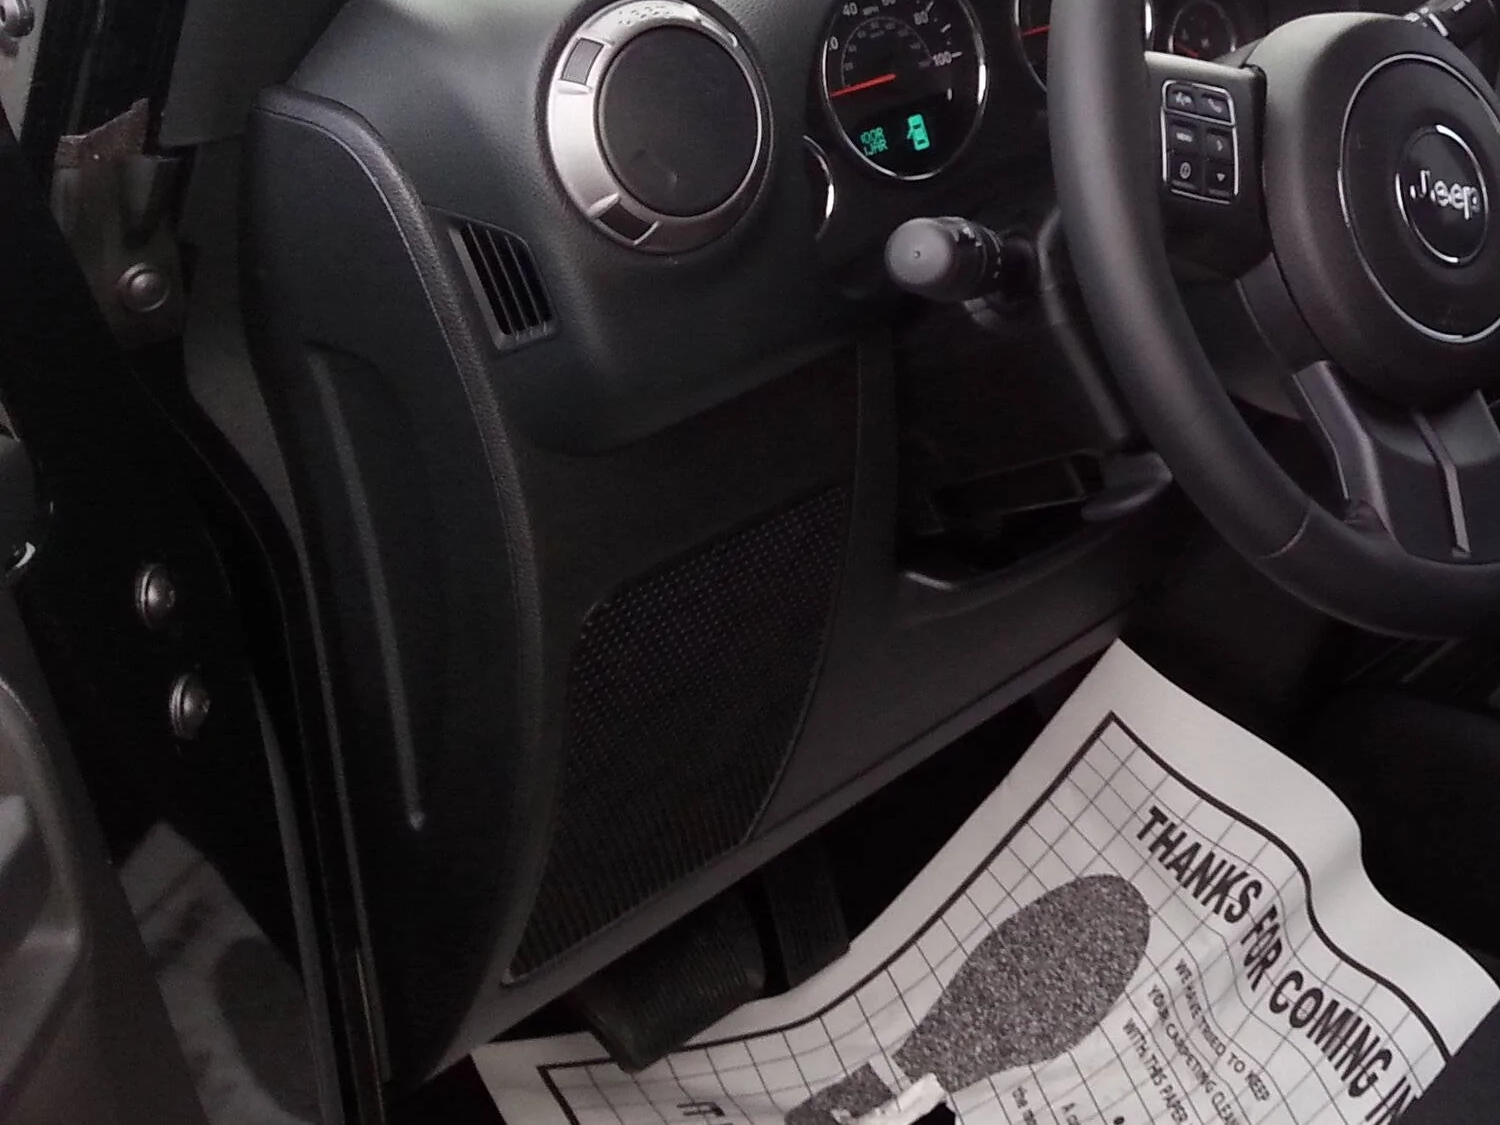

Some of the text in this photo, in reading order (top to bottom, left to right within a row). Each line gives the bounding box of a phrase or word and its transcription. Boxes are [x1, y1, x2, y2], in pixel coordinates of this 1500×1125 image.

[842, 2, 858, 15] 40
[932, 51, 952, 67] 100
[1410, 169, 1481, 220] Jeep
[1137, 806, 1262, 923] THANKS
[1241, 905, 1282, 992] FOR
[1269, 970, 1393, 1098] COMING
[1123, 1017, 1189, 1125] WITH THIS PAPER
[1148, 984, 1171, 1025] YOUR
[1166, 1022, 1217, 1095] CARPETING
[1175, 959, 1193, 984] WE
[1200, 1016, 1226, 1057] TRIED
[1227, 1052, 1246, 1074] TO
[1244, 1070, 1271, 1102] KEEP
